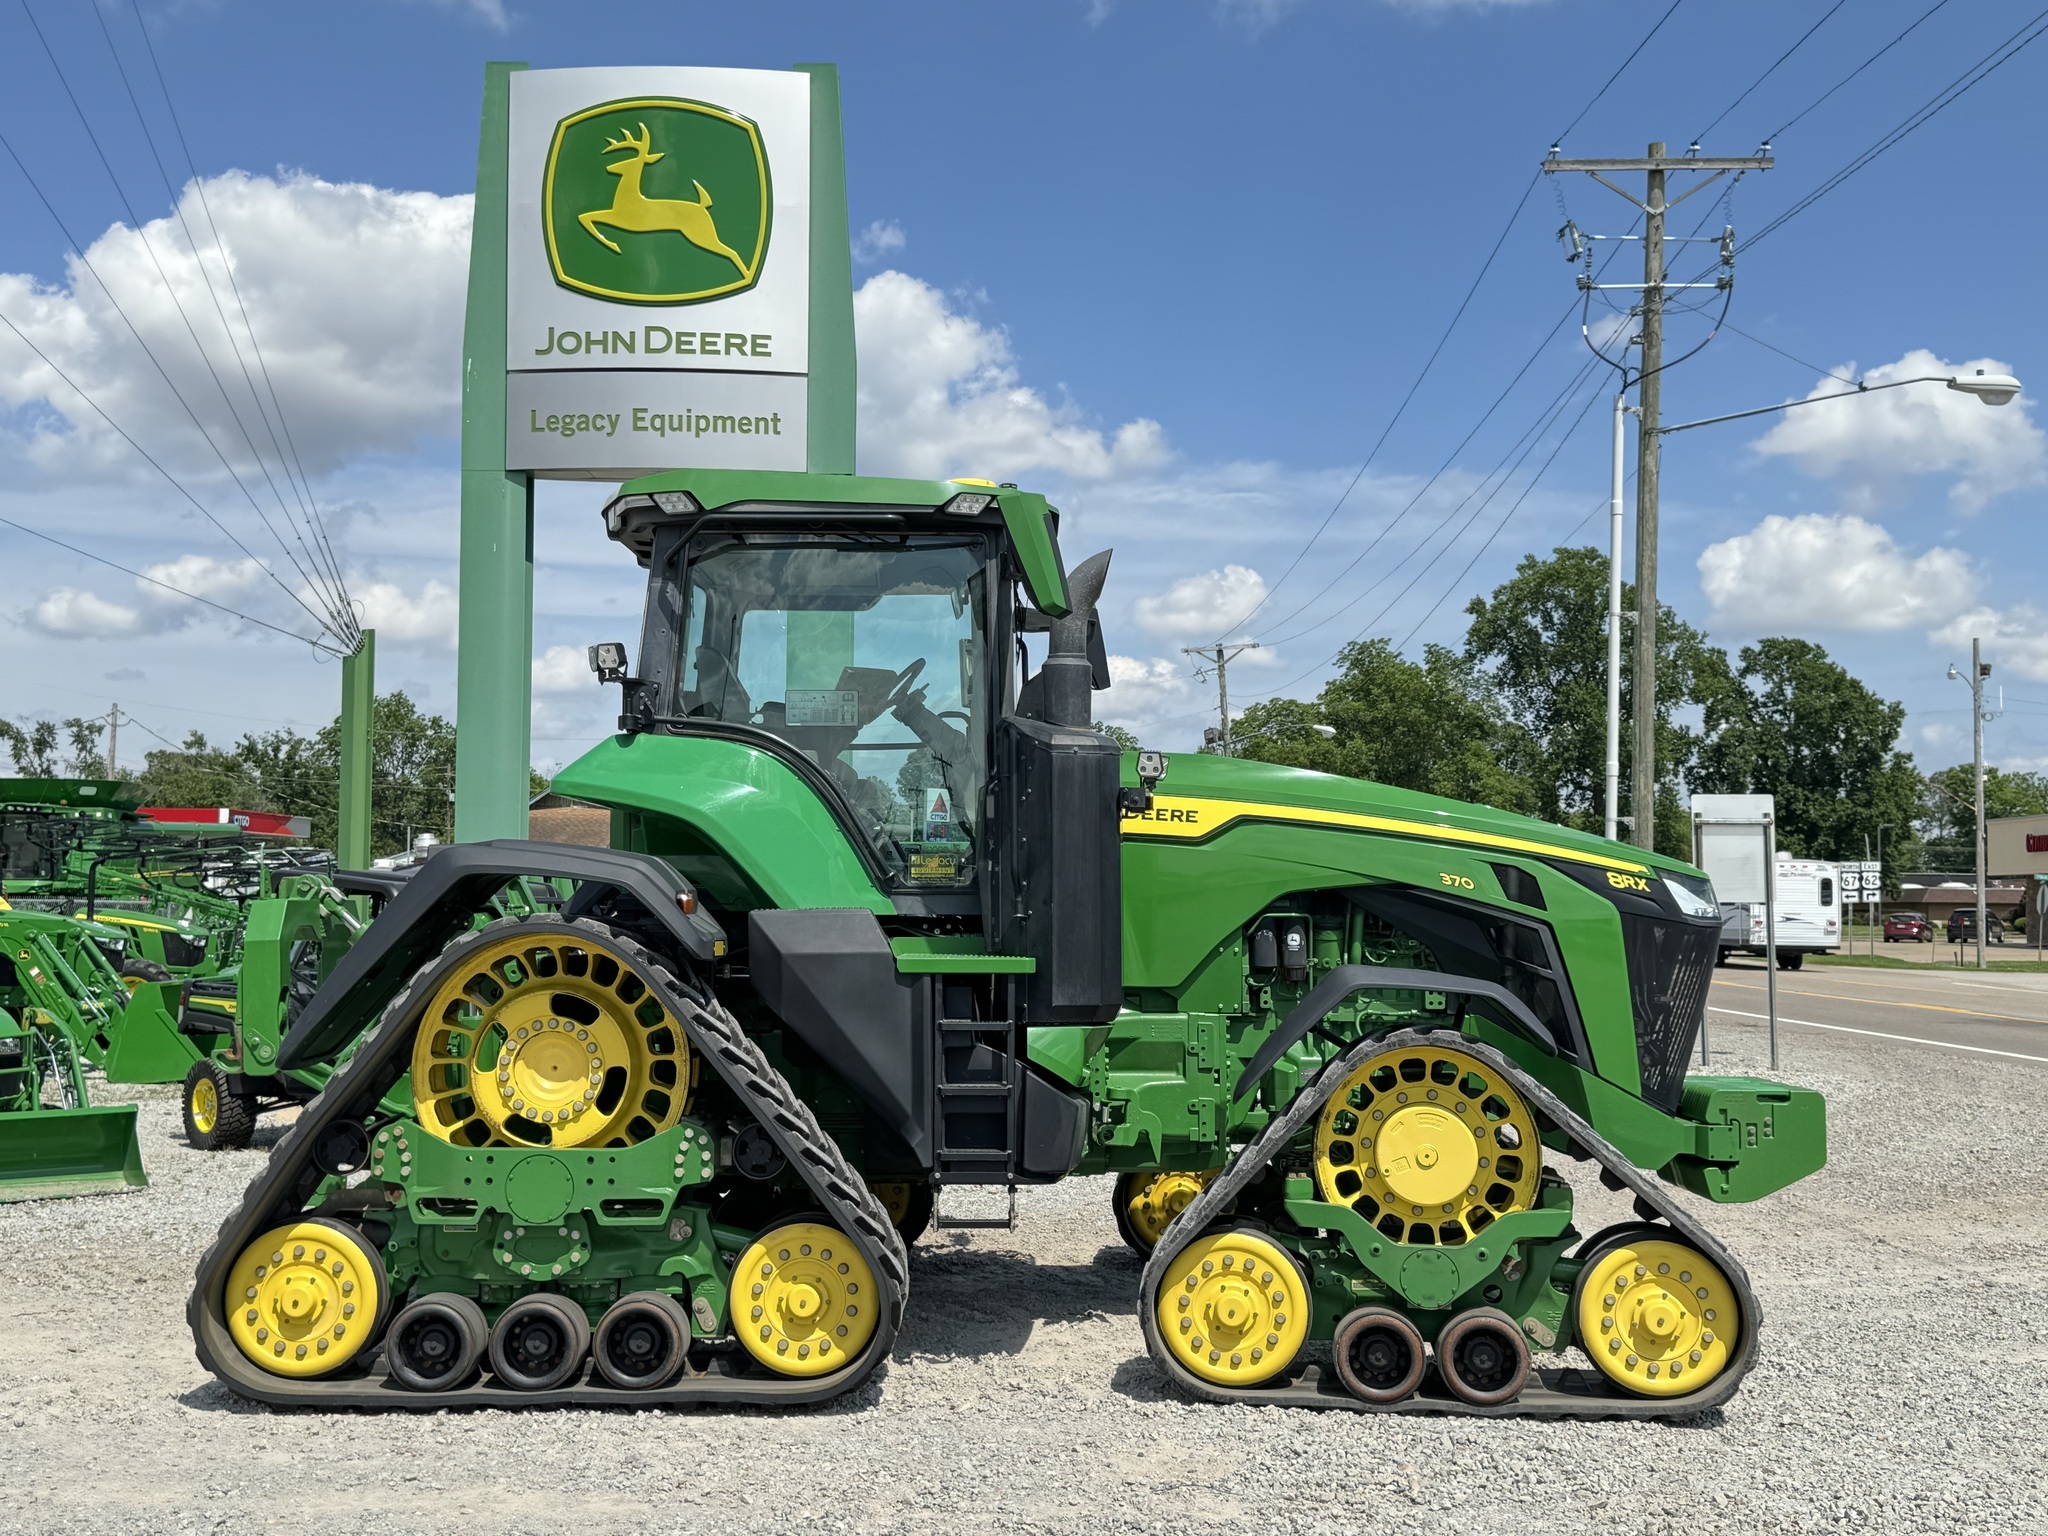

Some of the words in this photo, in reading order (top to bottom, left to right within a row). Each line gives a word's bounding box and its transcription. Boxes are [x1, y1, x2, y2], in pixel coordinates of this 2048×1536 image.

[534, 326, 636, 356] JOHN
[644, 325, 772, 357] DEERE
[530, 409, 621, 438] Legacy
[632, 408, 782, 438] Equipment
[920, 856, 956, 867] Leacy
[1438, 872, 1476, 890] 370
[1605, 871, 1651, 892] 8RX
[1843, 876, 1857, 887] 67
[1864, 875, 1878, 886] 62
